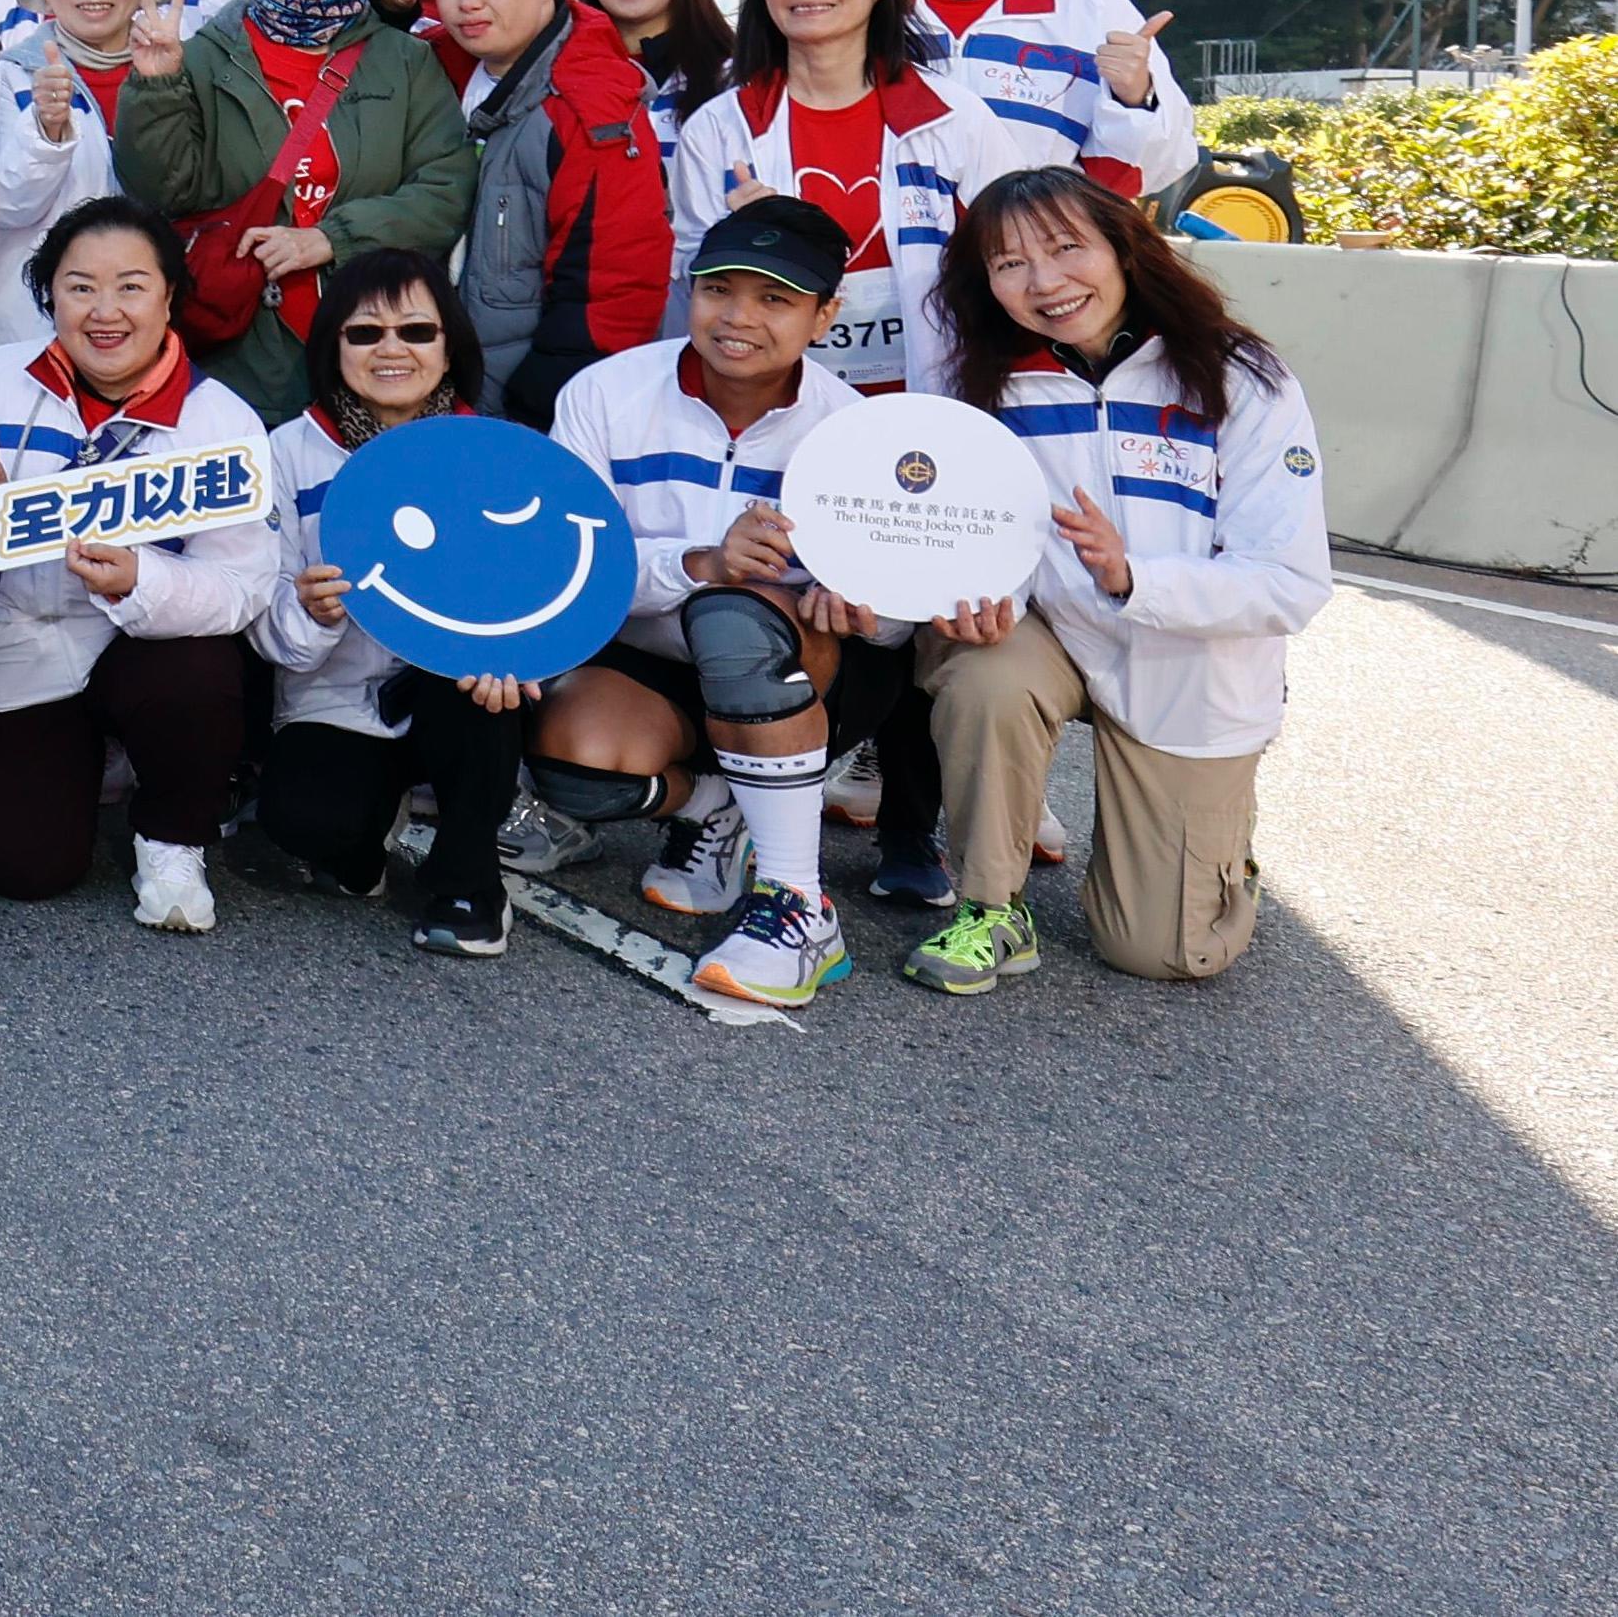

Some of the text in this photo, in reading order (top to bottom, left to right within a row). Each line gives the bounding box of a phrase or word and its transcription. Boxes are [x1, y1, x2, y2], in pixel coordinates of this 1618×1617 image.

[1121, 438, 1189, 460] CARE
[8, 456, 253, 548] 全力以赴
[834, 510, 994, 536] The Hong Kong Jockey Club
[870, 530, 955, 549] Charities Trust
